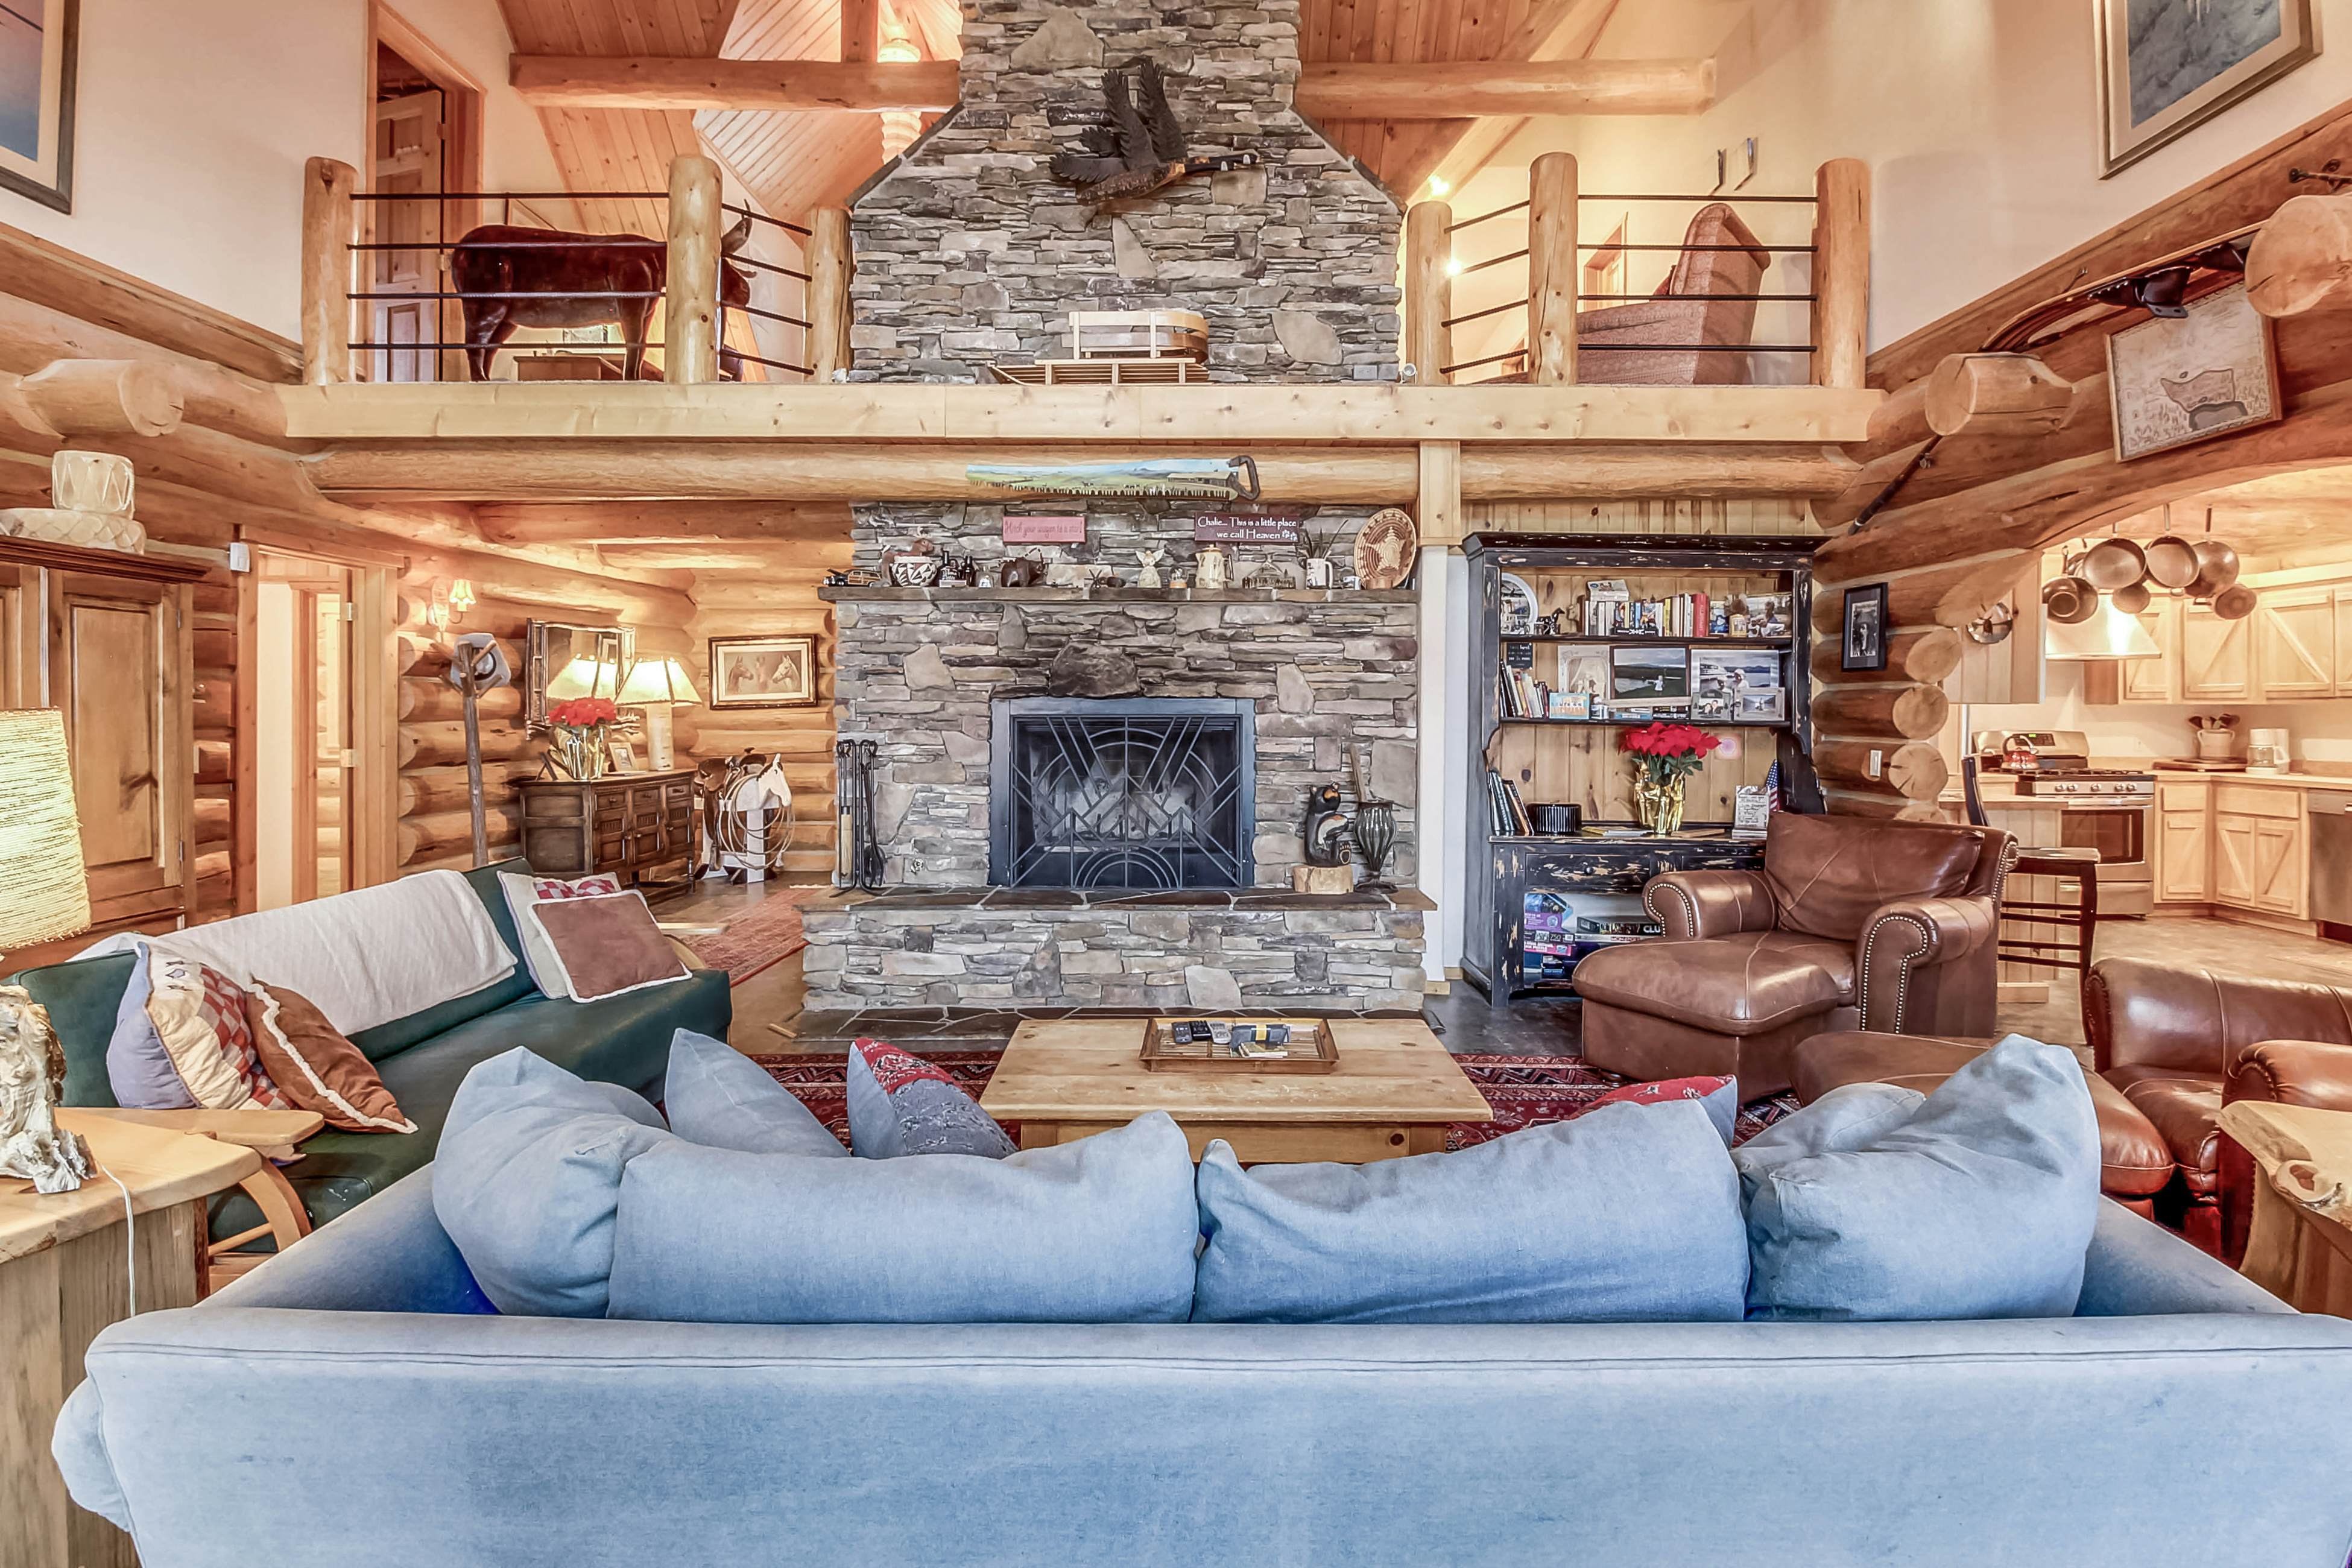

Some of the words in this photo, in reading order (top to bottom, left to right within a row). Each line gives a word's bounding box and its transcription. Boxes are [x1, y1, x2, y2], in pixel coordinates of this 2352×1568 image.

[1229, 516, 1247, 527] This
[1248, 518, 1254, 526] is
[1261, 517, 1276, 526] little
[1277, 517, 1297, 530] place
[1023, 526, 1036, 539] your
[1037, 526, 1056, 539] wagon
[1057, 524, 1062, 533] to
[1230, 529, 1244, 538] call
[1246, 529, 1280, 539] Heaven
[1643, 925, 1660, 934] CLU
